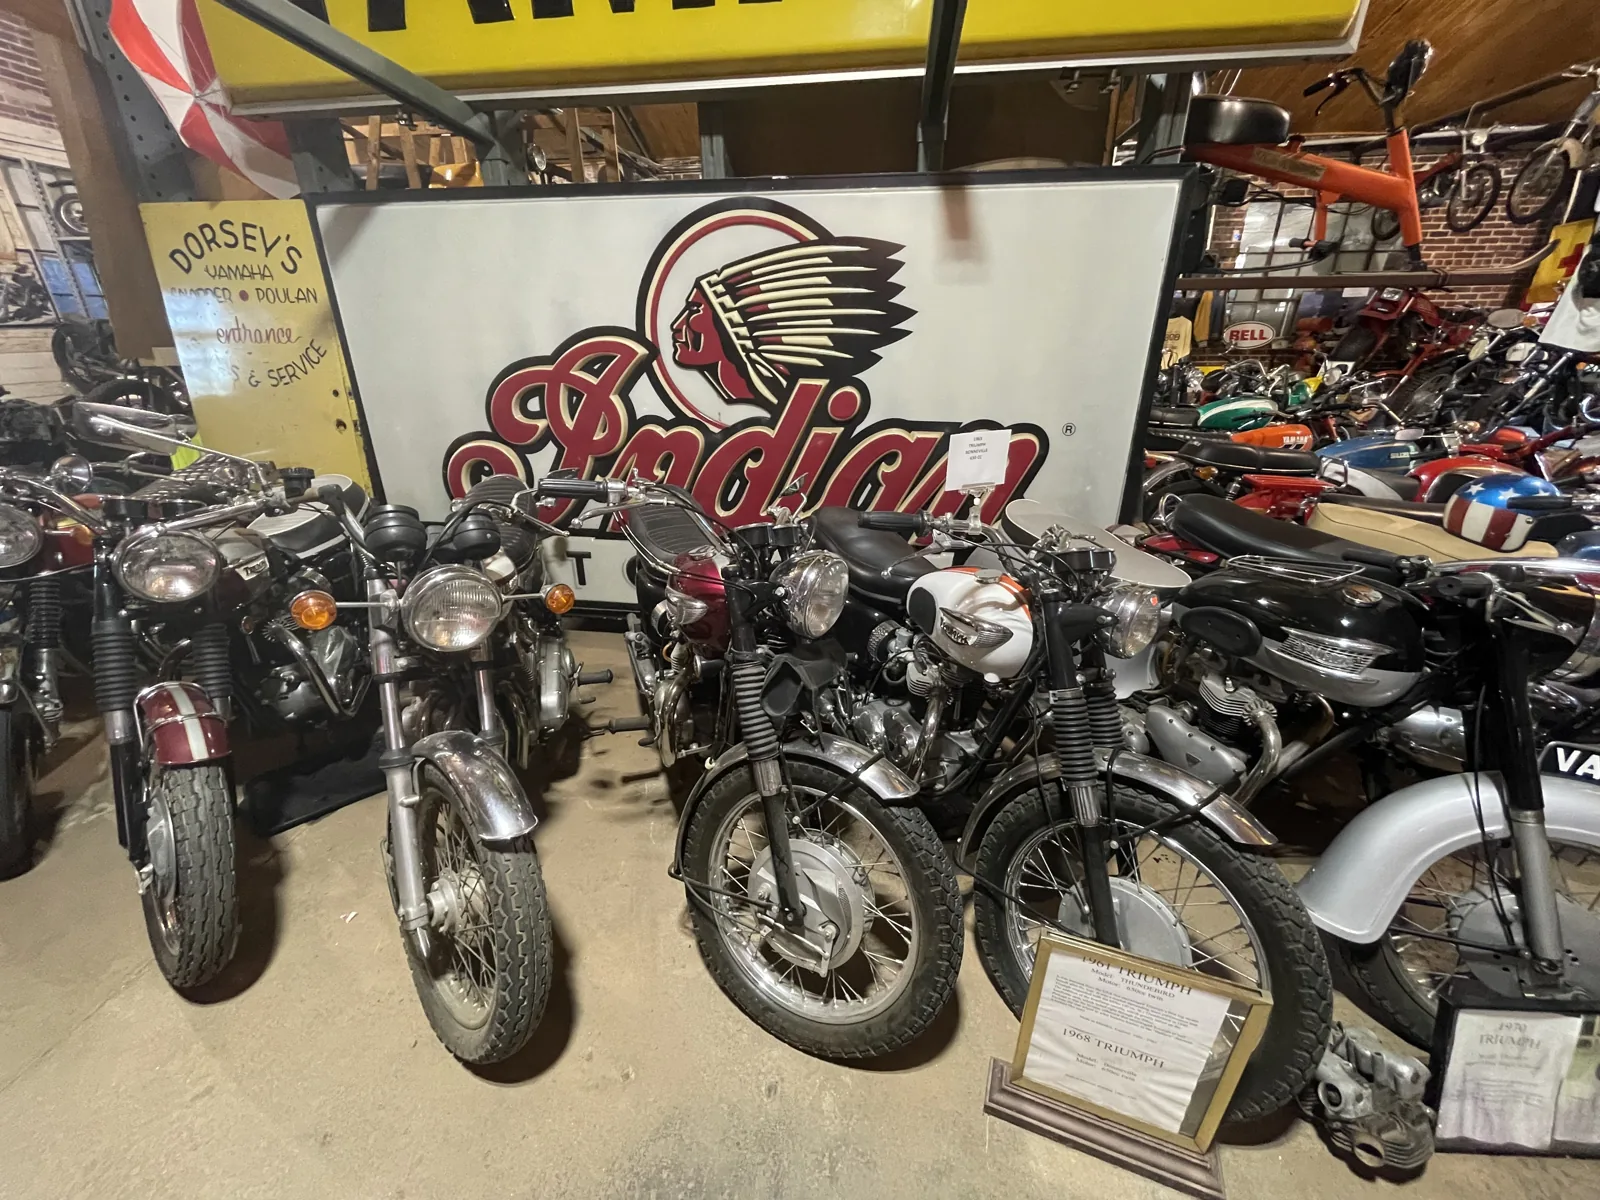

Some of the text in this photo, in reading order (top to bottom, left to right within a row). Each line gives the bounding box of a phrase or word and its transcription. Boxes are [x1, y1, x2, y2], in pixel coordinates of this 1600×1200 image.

[169, 219, 302, 274] DORSEY'S
[204, 264, 274, 281] YAMAHA
[255, 287, 318, 304] POULAN
[216, 315, 303, 345] entrance
[1229, 329, 1268, 341] BELL
[248, 370, 261, 387] &
[267, 339, 327, 388] SERVICE
[446, 334, 1042, 546] Indian
[1118, 966, 1194, 995] TRIUMPH
[1062, 1028, 1092, 1043] 1968
[1094, 1038, 1165, 1069] TRIUMPH
